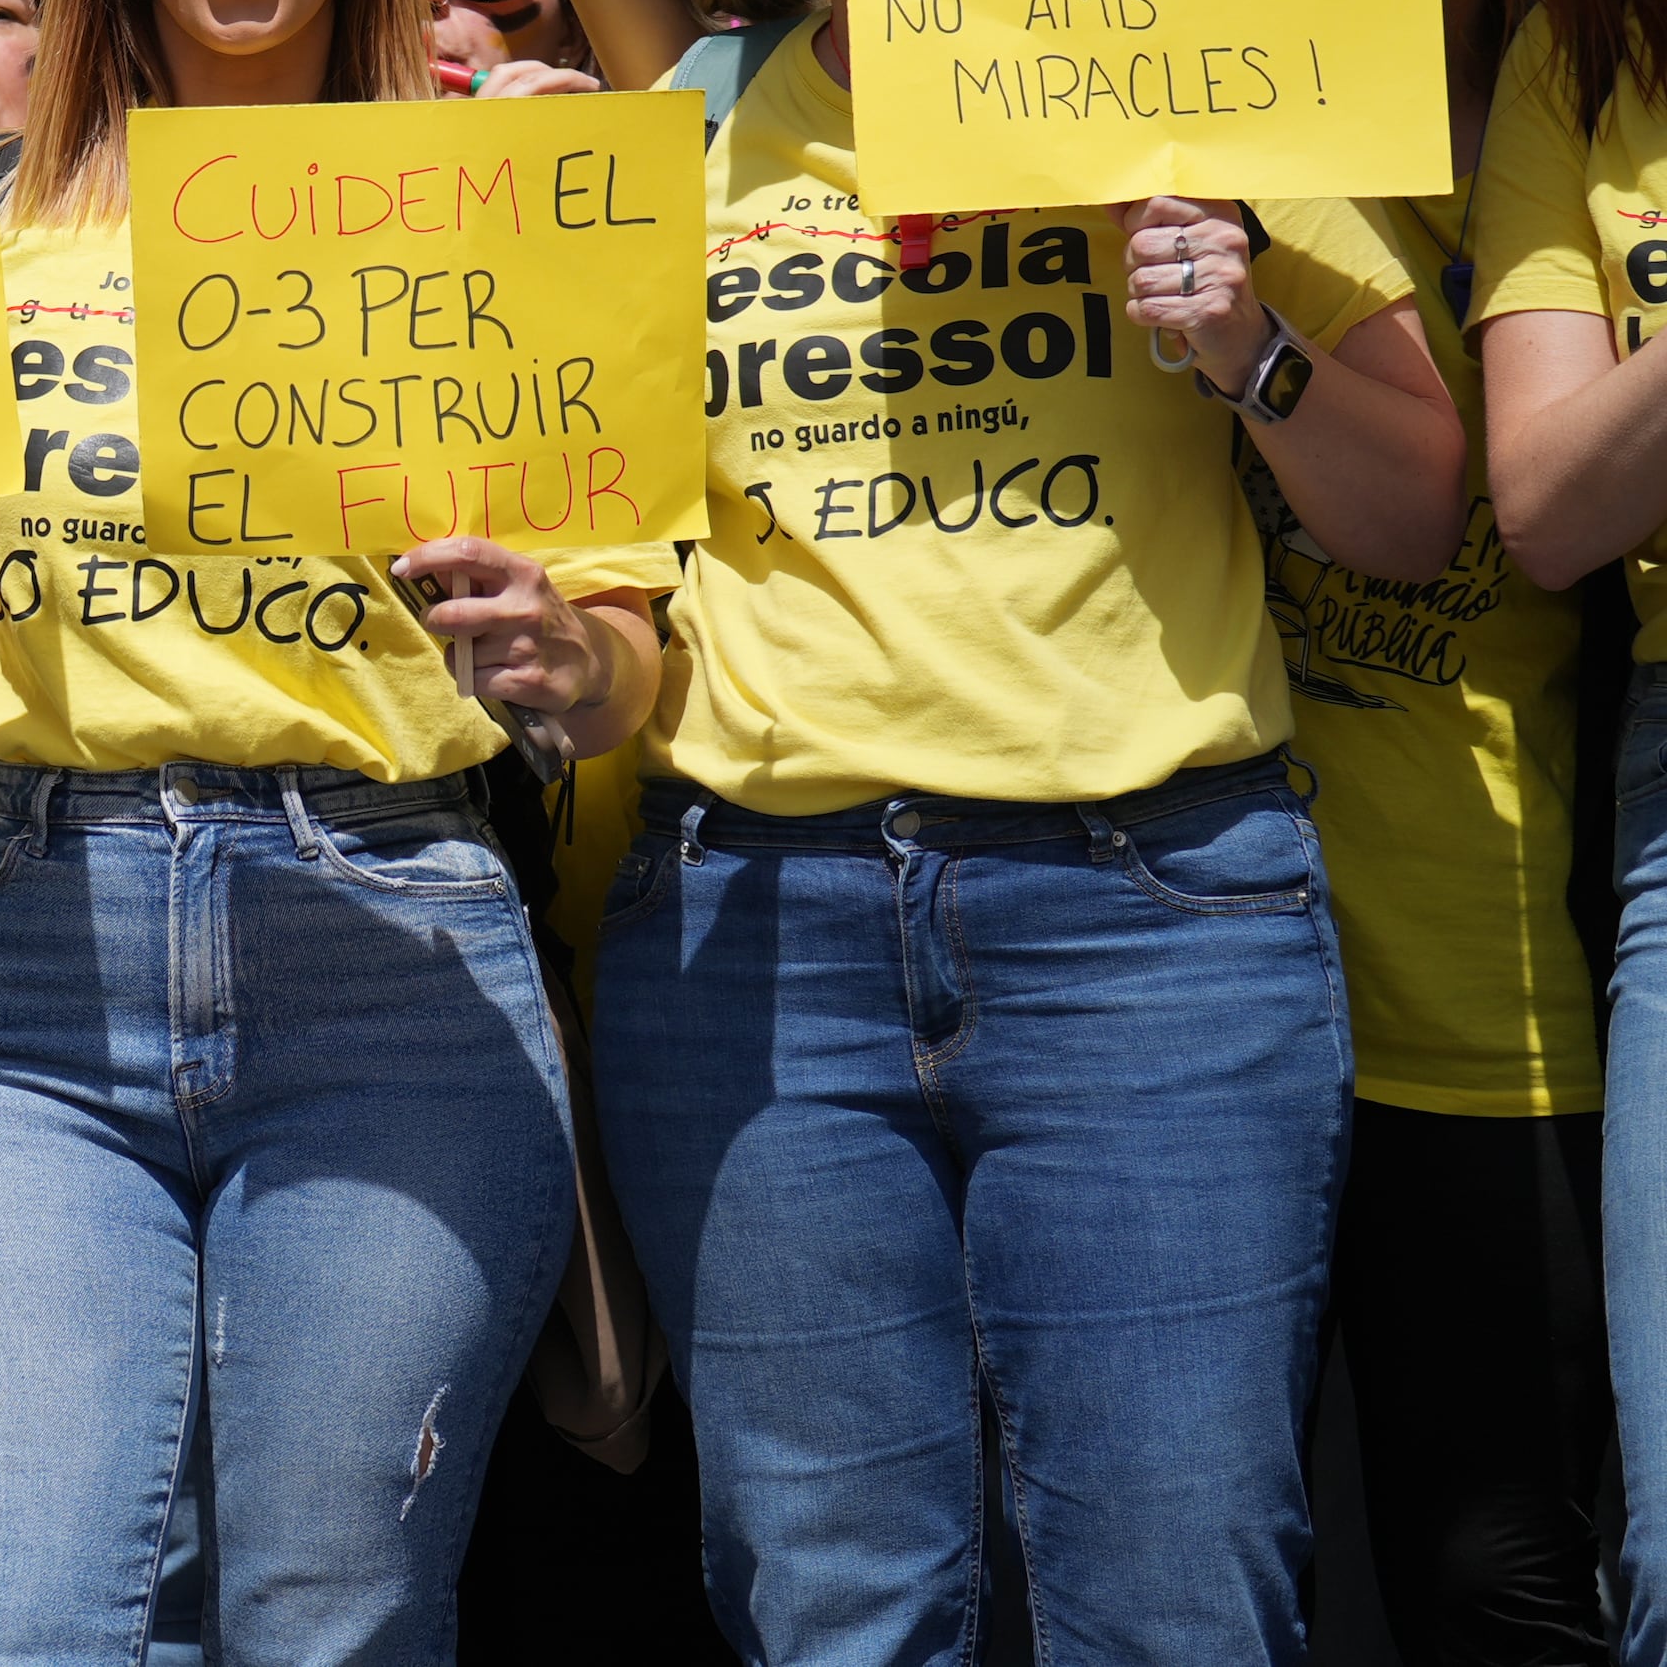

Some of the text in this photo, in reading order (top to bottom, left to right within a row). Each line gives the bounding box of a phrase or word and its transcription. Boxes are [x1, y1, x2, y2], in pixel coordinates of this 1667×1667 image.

[952, 44, 1278, 125] MIRACLES
[554, 148, 656, 229] EL
[781, 194, 811, 213] Jo
[99, 271, 131, 291] Jo
[178, 264, 514, 357] 0-3 PER
[706, 221, 1092, 324] escola
[750, 397, 1031, 453] no guardo a ningú,
[21, 516, 51, 537] no
[187, 444, 642, 550] EL FUTUR
[814, 454, 1114, 543] EDUCO.
[77, 554, 370, 653] EDUCO.
